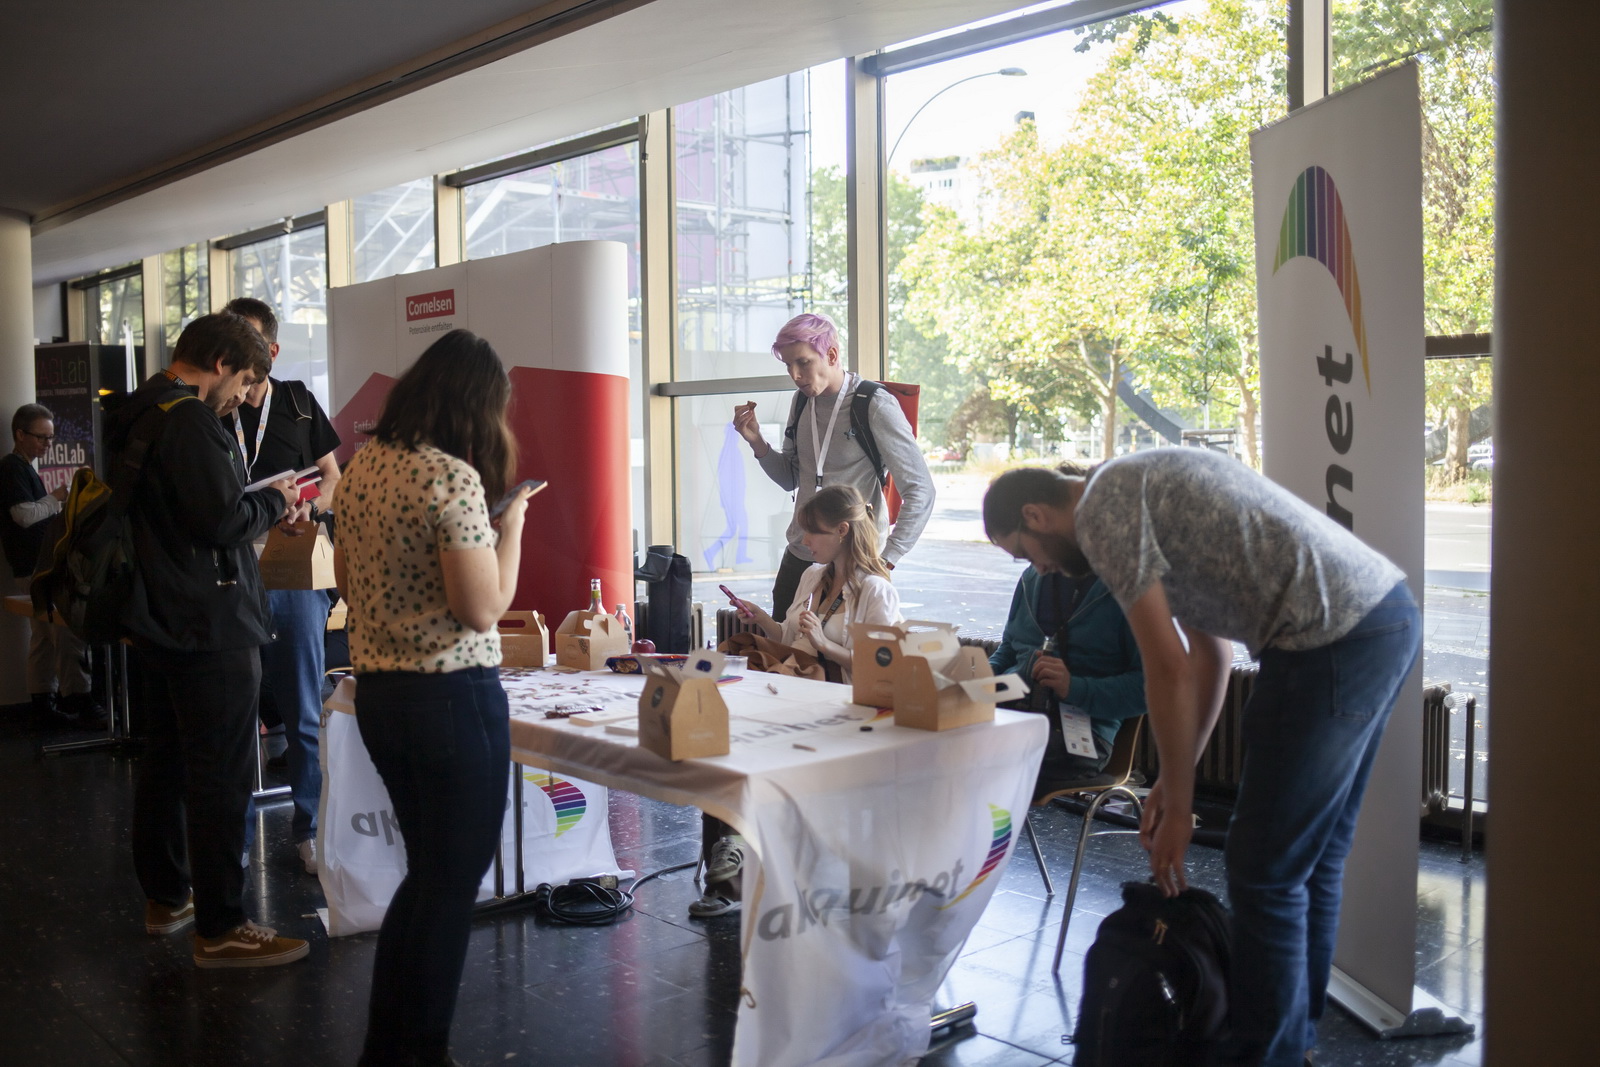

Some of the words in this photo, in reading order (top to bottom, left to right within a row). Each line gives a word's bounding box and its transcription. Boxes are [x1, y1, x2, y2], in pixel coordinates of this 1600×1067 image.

[408, 296, 452, 316] Cornelsen
[408, 323, 431, 335] Potenziale
[431, 321, 453, 332] entfalten
[757, 857, 964, 942] akquinet
